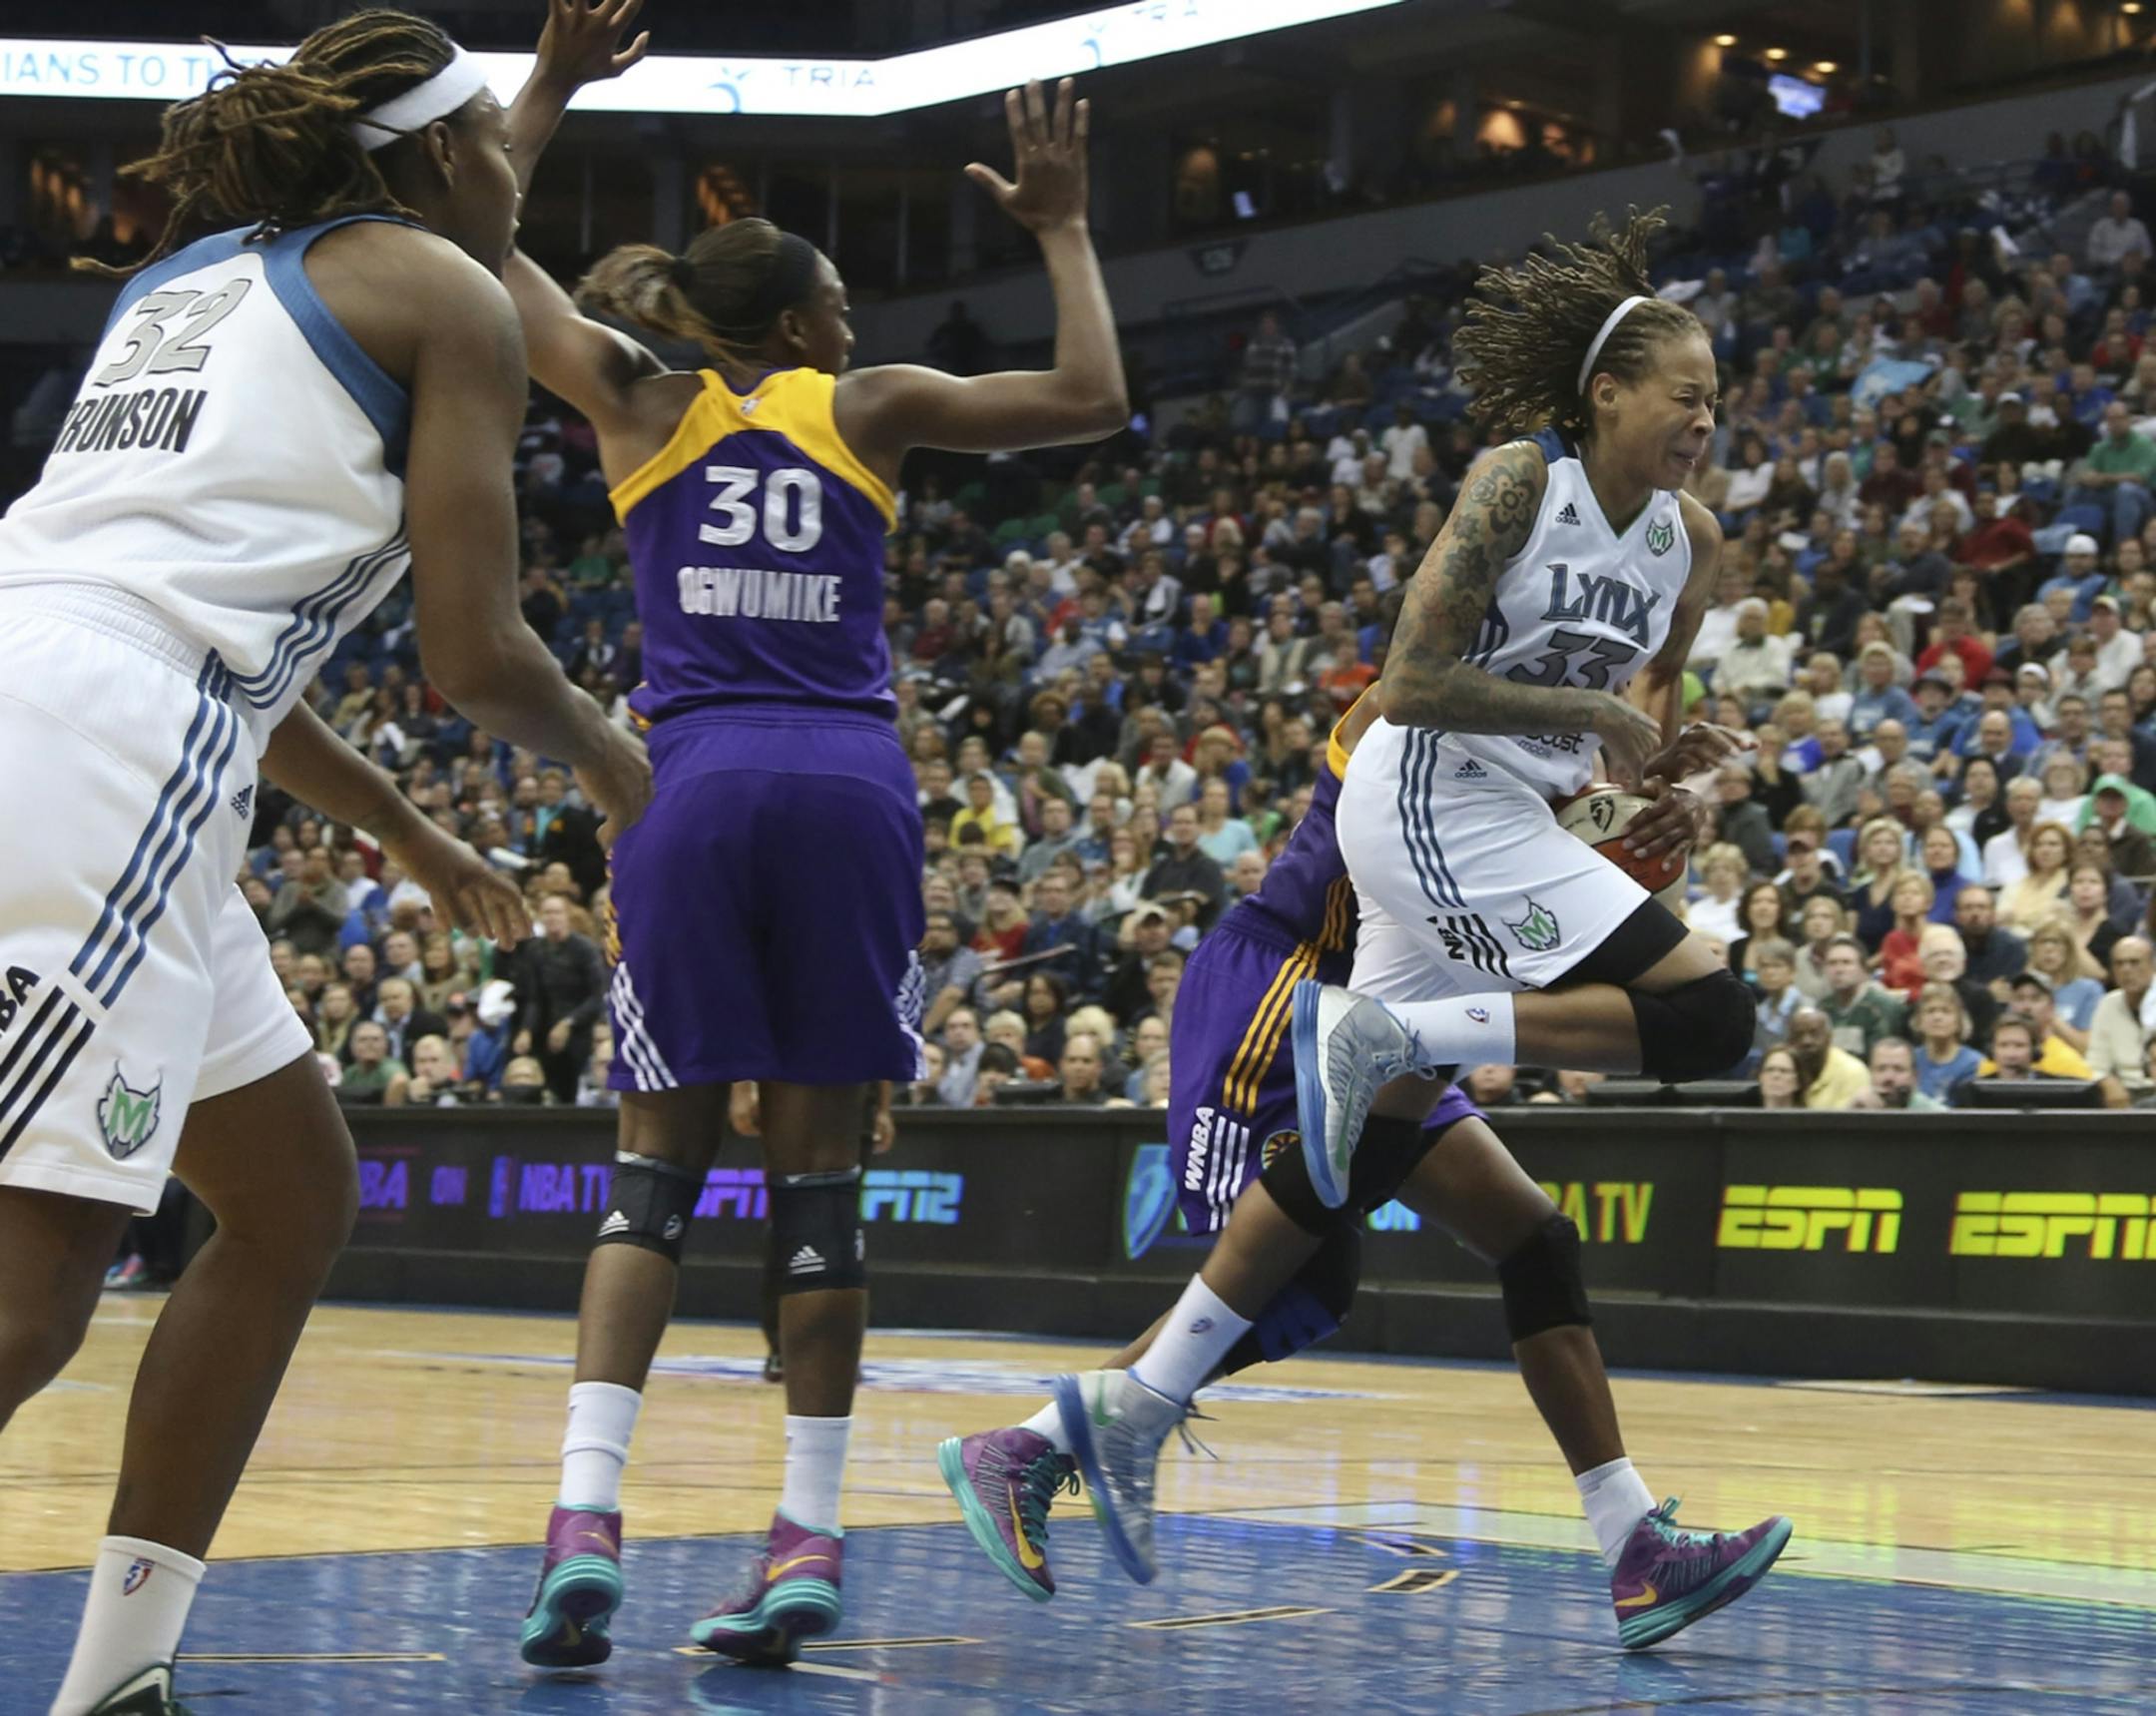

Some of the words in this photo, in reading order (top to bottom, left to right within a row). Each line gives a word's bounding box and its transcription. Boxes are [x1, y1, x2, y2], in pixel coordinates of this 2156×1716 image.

[116, 55, 167, 87] TO
[782, 66, 875, 88] TRIA
[94, 279, 253, 387] 32
[699, 465, 823, 552] 30
[677, 566, 842, 622] OGWUMIKE
[1540, 563, 1662, 651] LYNX
[1504, 629, 1638, 689] 33
[1185, 1106, 1215, 1191] WNBA
[1593, 1182, 1655, 1244] TV
[1716, 1185, 1903, 1253] ESPN
[1948, 1191, 2156, 1260] ESPN
